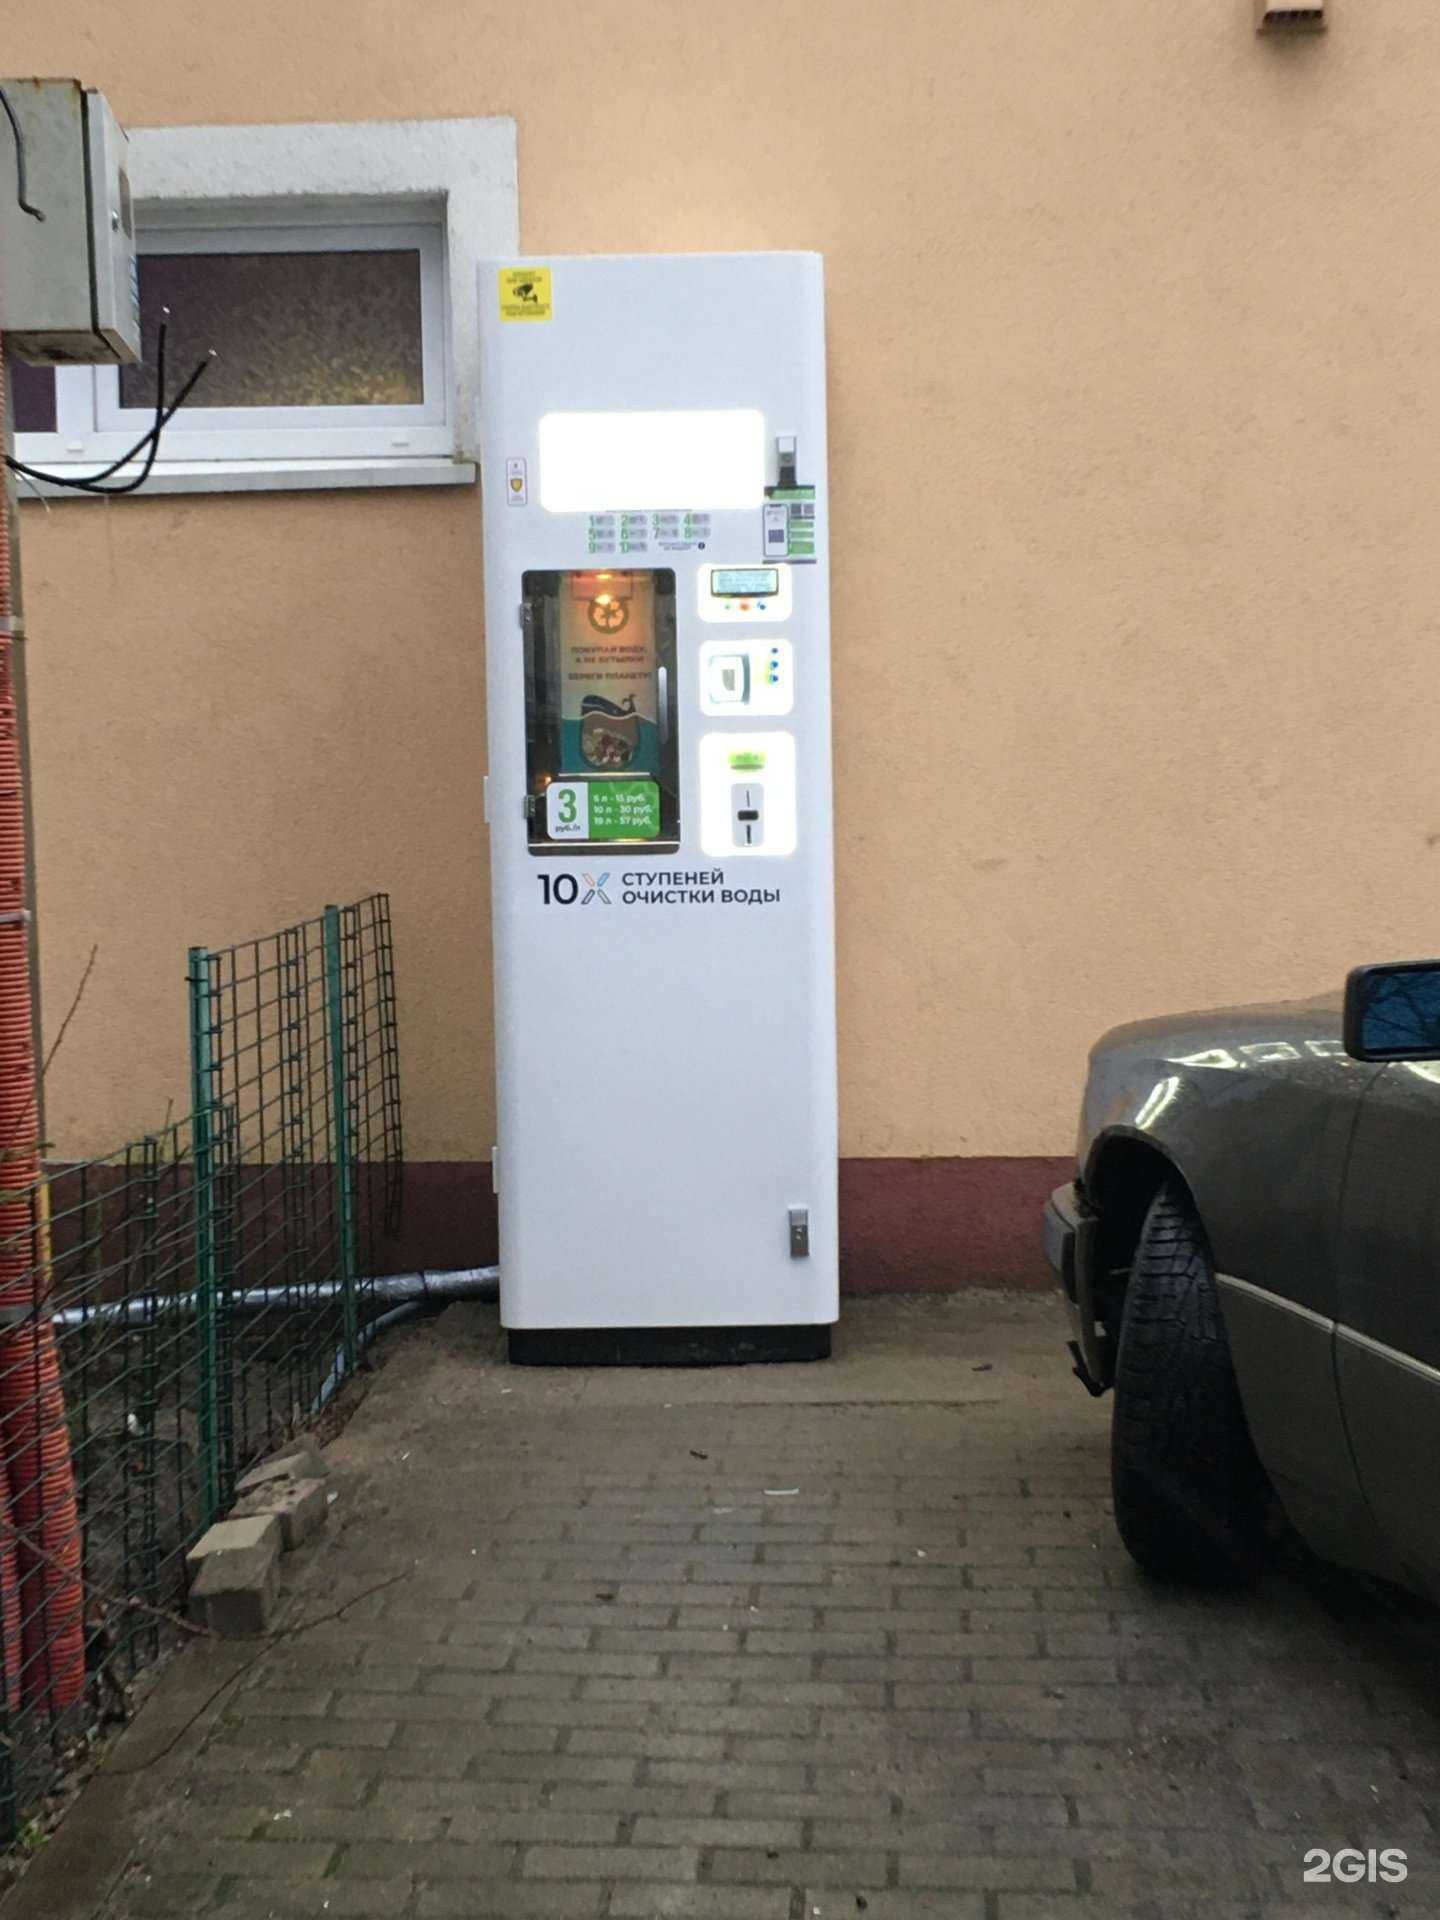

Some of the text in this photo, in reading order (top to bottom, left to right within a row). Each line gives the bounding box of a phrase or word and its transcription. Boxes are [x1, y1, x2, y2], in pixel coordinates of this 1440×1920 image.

[558, 788, 577, 823] 3
[593, 805, 604, 813] 10
[620, 805, 632, 813] 30
[620, 816, 631, 825] 57
[622, 868, 724, 886] СТУПЕНЕЙ
[622, 889, 780, 905] ОЧИСТКИ ВОДЫ
